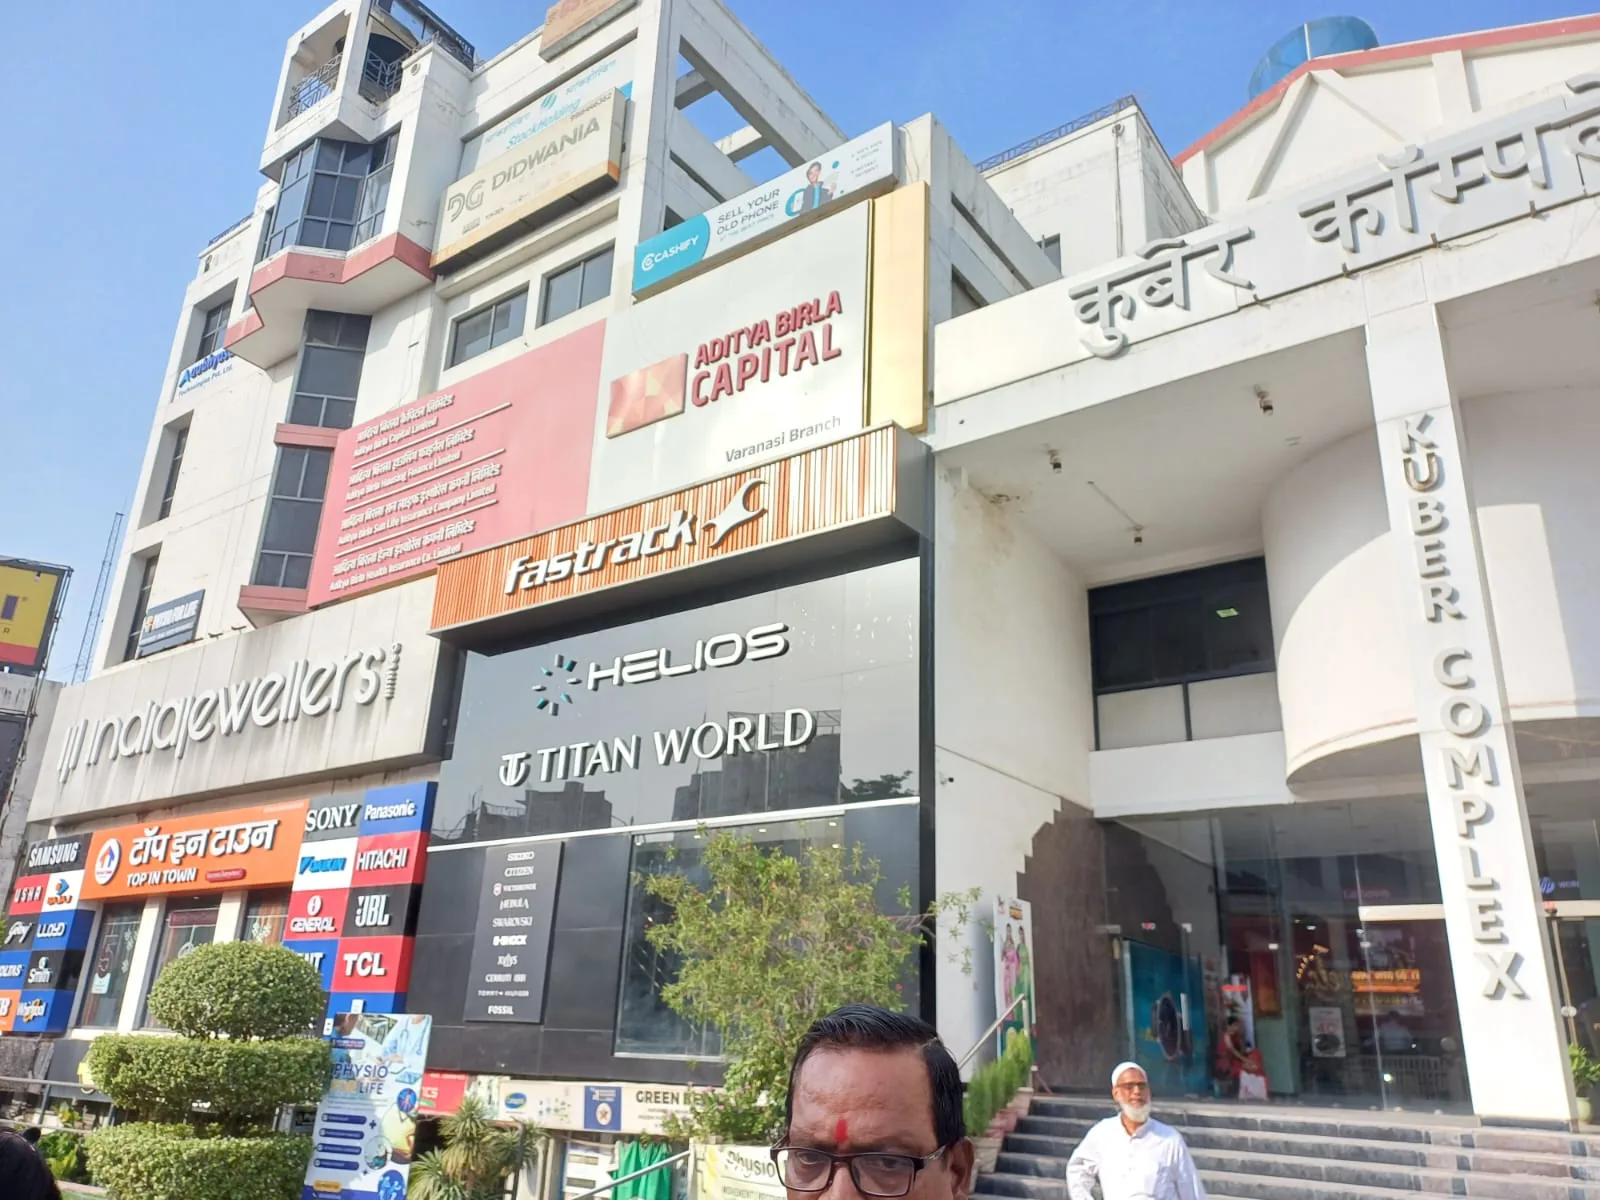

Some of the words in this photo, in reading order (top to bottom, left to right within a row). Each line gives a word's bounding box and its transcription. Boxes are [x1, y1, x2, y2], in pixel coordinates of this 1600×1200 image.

[491, 117, 600, 192] DIDWANIA
[717, 206, 744, 224] SELL
[747, 188, 780, 209] YOUR
[717, 220, 739, 236] OLD
[741, 200, 780, 225] PHONE
[654, 234, 699, 263] CASHIFY
[1068, 225, 1254, 359] कुबेर
[693, 319, 771, 369] ADITYA
[774, 289, 843, 338] BIRLA
[691, 323, 842, 408] CAPITAL
[725, 431, 786, 463] Varanasi
[789, 415, 842, 443] Branch
[1400, 412, 1468, 624] KUBER
[504, 510, 699, 595] fastrack
[587, 622, 790, 692] HELIOS
[538, 733, 641, 783] TITAN
[653, 707, 817, 766] WORLD
[304, 803, 361, 832] SONY
[364, 799, 416, 821] Panasonic
[1433, 647, 1531, 1000] COMPLEX
[29, 842, 79, 867] SAMSUNG
[128, 825, 170, 867] टॉप
[169, 828, 210, 866] इन
[210, 818, 281, 857] टाउन
[356, 847, 409, 871] HITACHI
[127, 871, 149, 887] TOP
[148, 870, 161, 885] IN
[162, 867, 199, 885] TOWN
[13, 886, 44, 904] USHA
[355, 893, 391, 928] JBL
[289, 917, 336, 933] GENERAL
[343, 951, 387, 977] TCL
[488, 1004, 514, 1016] FOSSIL
[334, 1063, 389, 1079] PHYSIO
[358, 1081, 384, 1095] LIFE
[636, 1090, 680, 1105] GREEN
